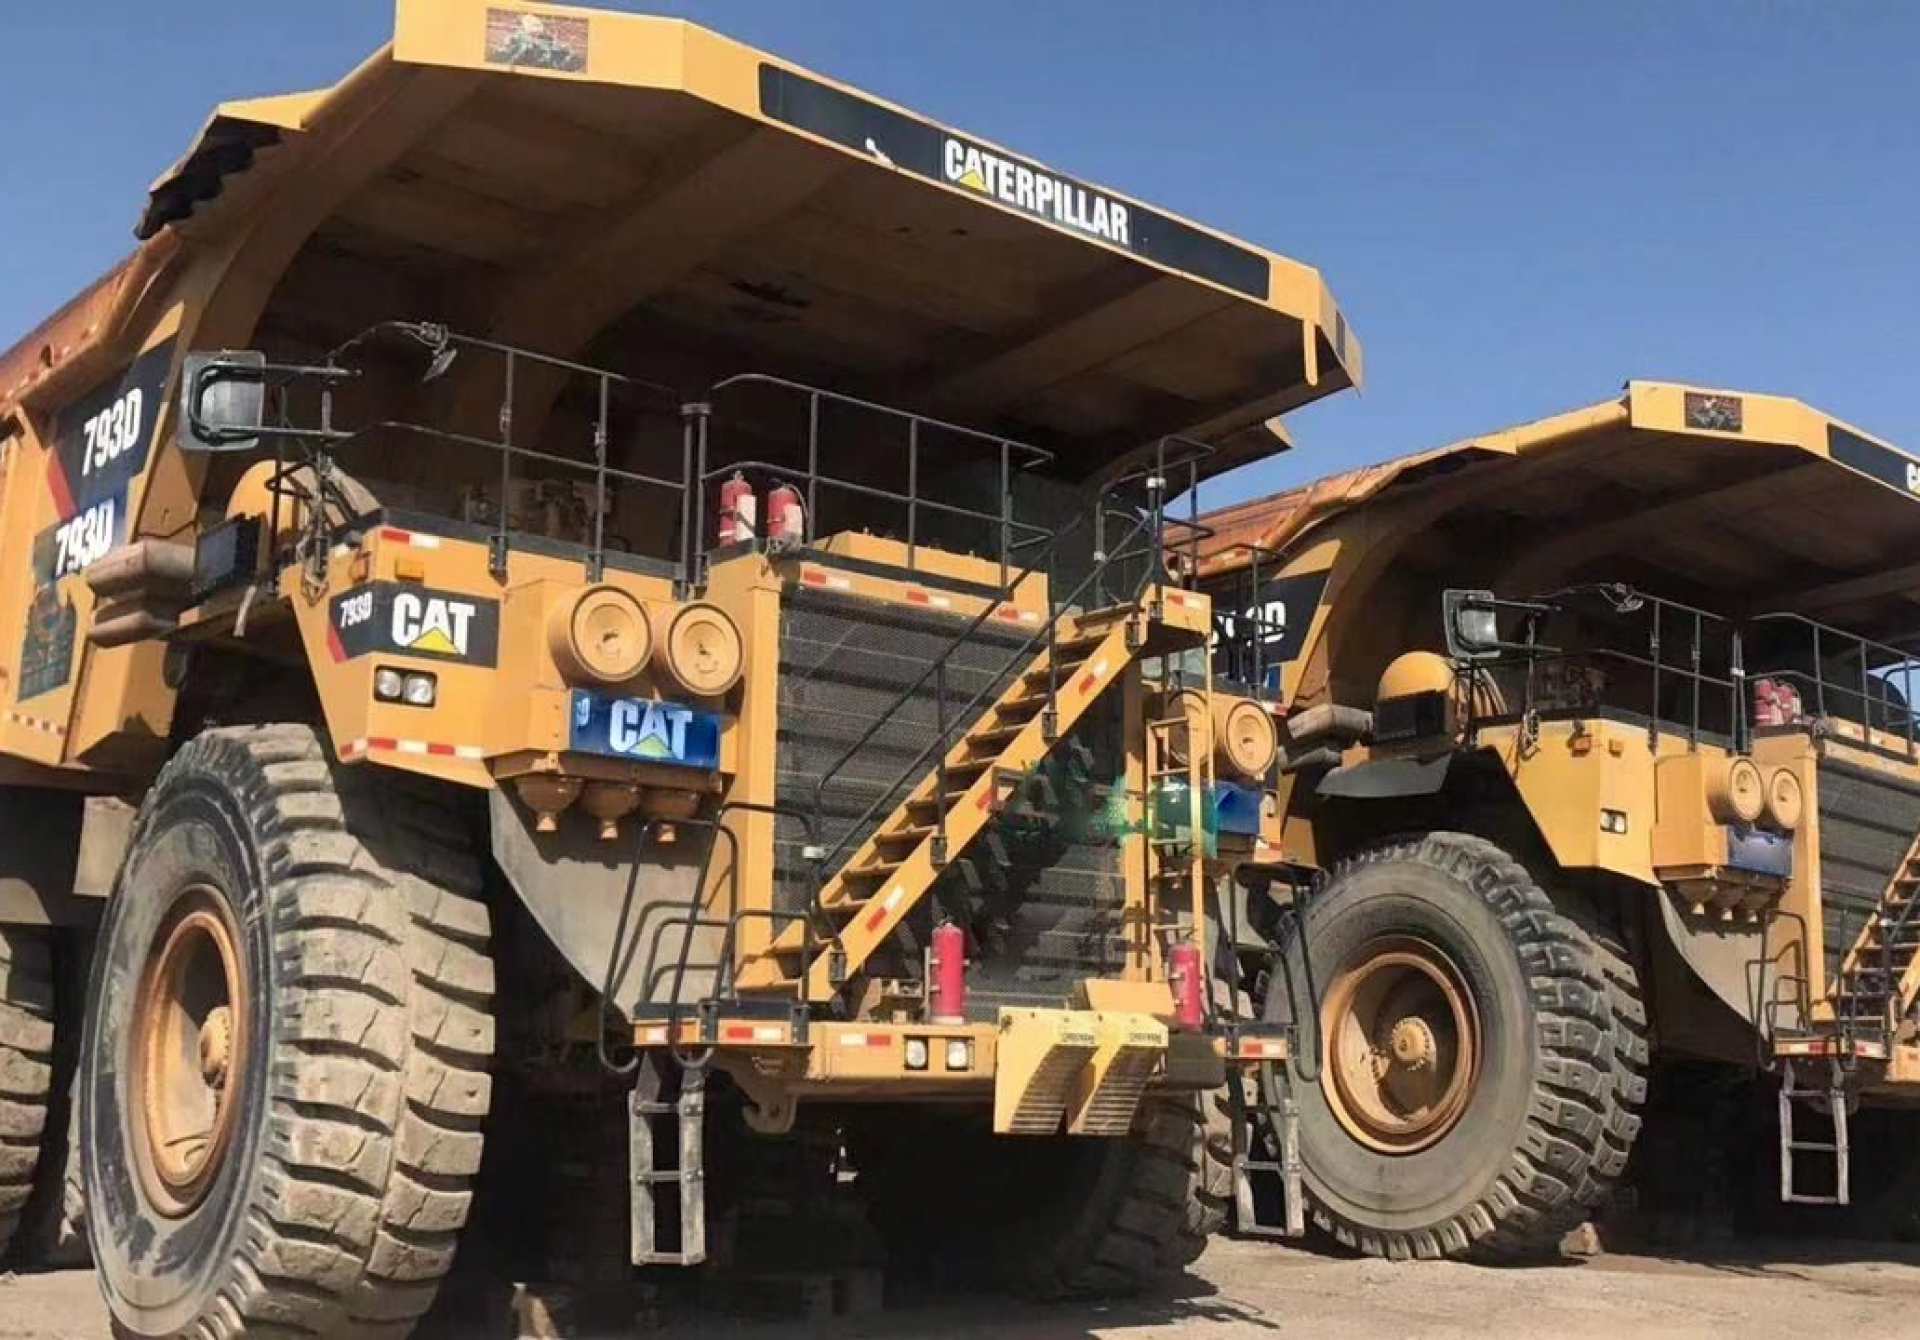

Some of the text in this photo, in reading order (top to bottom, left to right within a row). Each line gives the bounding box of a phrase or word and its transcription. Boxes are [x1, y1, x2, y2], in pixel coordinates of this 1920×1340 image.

[944, 138, 1129, 245] CATERPILLAR
[82, 387, 142, 476] 793D
[392, 592, 476, 656] CAT
[609, 699, 693, 760] CAT
